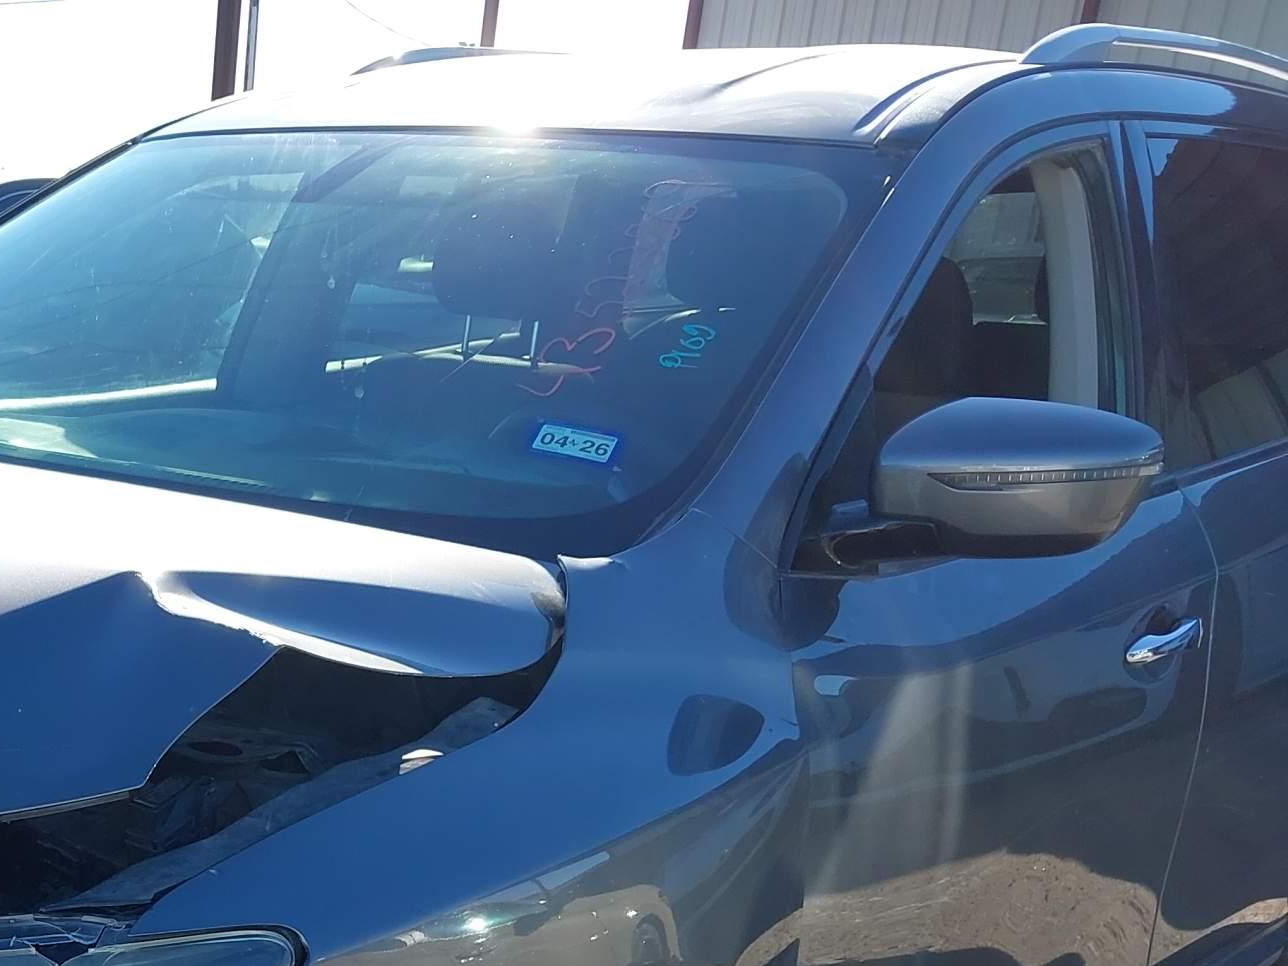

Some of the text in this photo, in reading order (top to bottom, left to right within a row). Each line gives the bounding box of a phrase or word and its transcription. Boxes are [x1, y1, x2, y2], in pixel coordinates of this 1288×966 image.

[515, 178, 728, 397] 4352
[539, 432, 611, 457] 04 26
